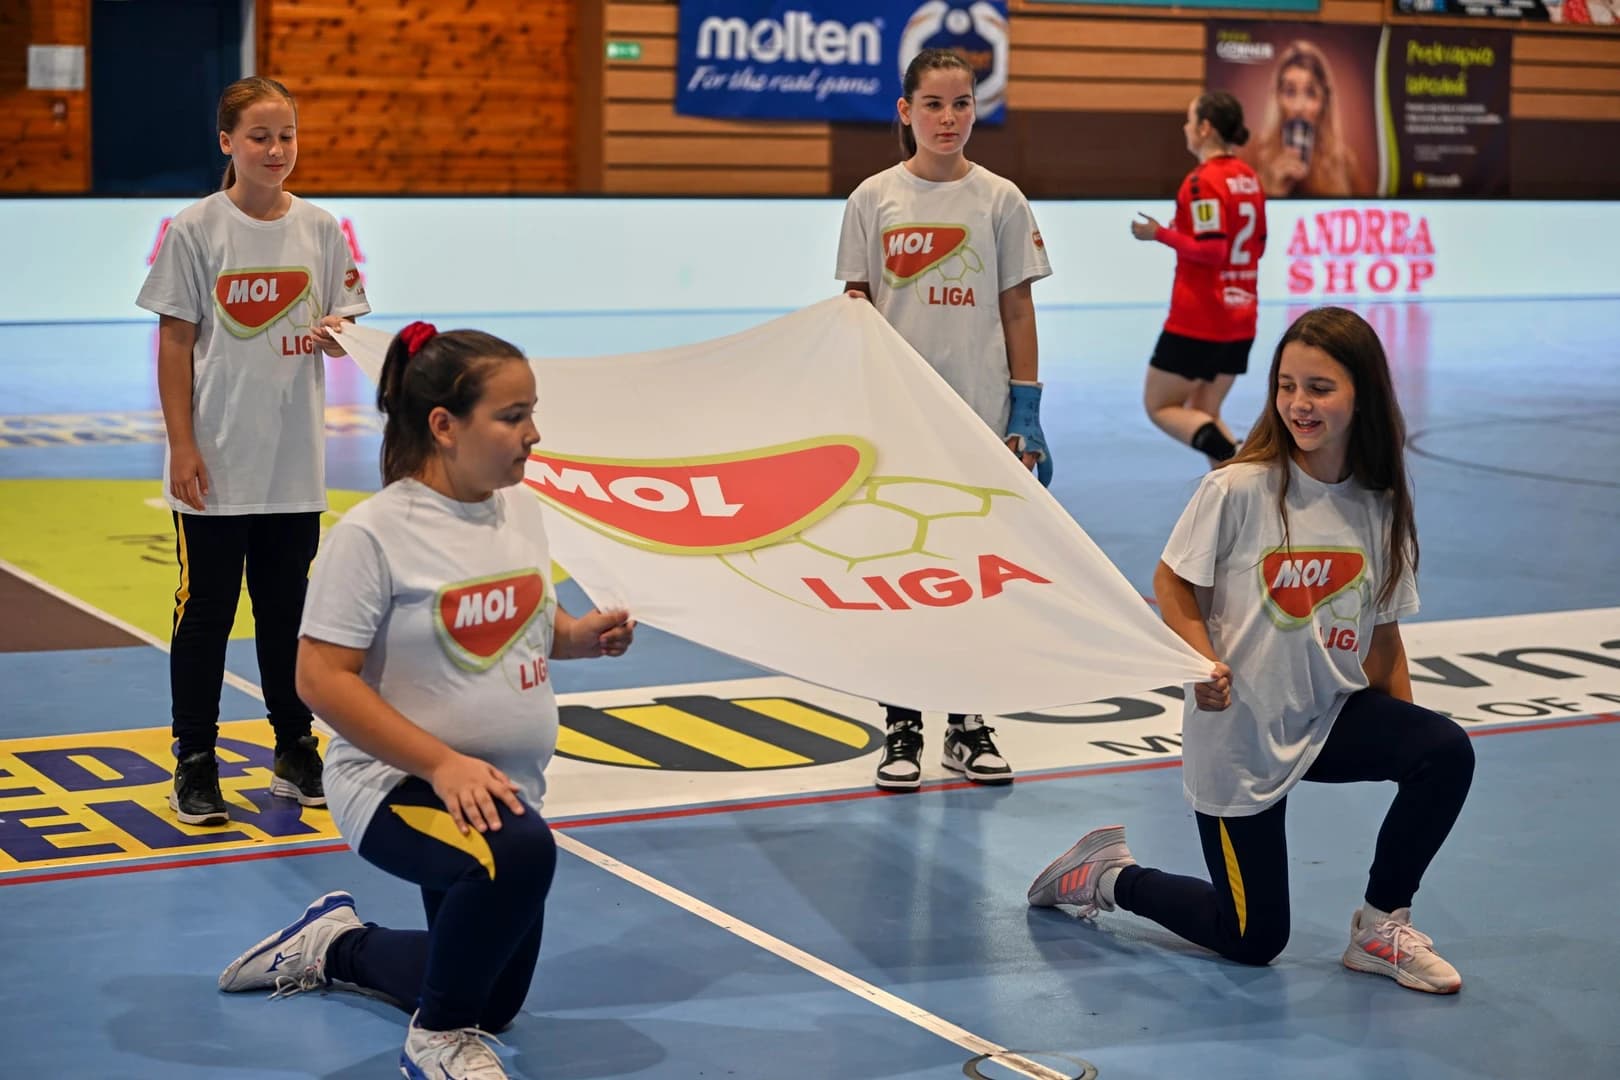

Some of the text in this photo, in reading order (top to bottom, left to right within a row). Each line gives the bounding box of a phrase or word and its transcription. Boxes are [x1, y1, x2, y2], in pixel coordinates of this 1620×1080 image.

[696, 10, 881, 66] molten
[687, 65, 727, 92] For
[727, 65, 768, 92] the
[885, 232, 934, 257] MOL
[1230, 202, 1256, 265] 2
[1287, 209, 1436, 257] ANDREA
[226, 278, 280, 304] MOL
[1287, 260, 1436, 294] SHOP
[928, 287, 976, 307] LIGA
[282, 335, 315, 356] LIG
[523, 458, 745, 518] MOL
[800, 554, 1053, 611] LIGA
[1272, 558, 1332, 589] MOL
[454, 585, 518, 629] MOL
[519, 656, 548, 691] LIG
